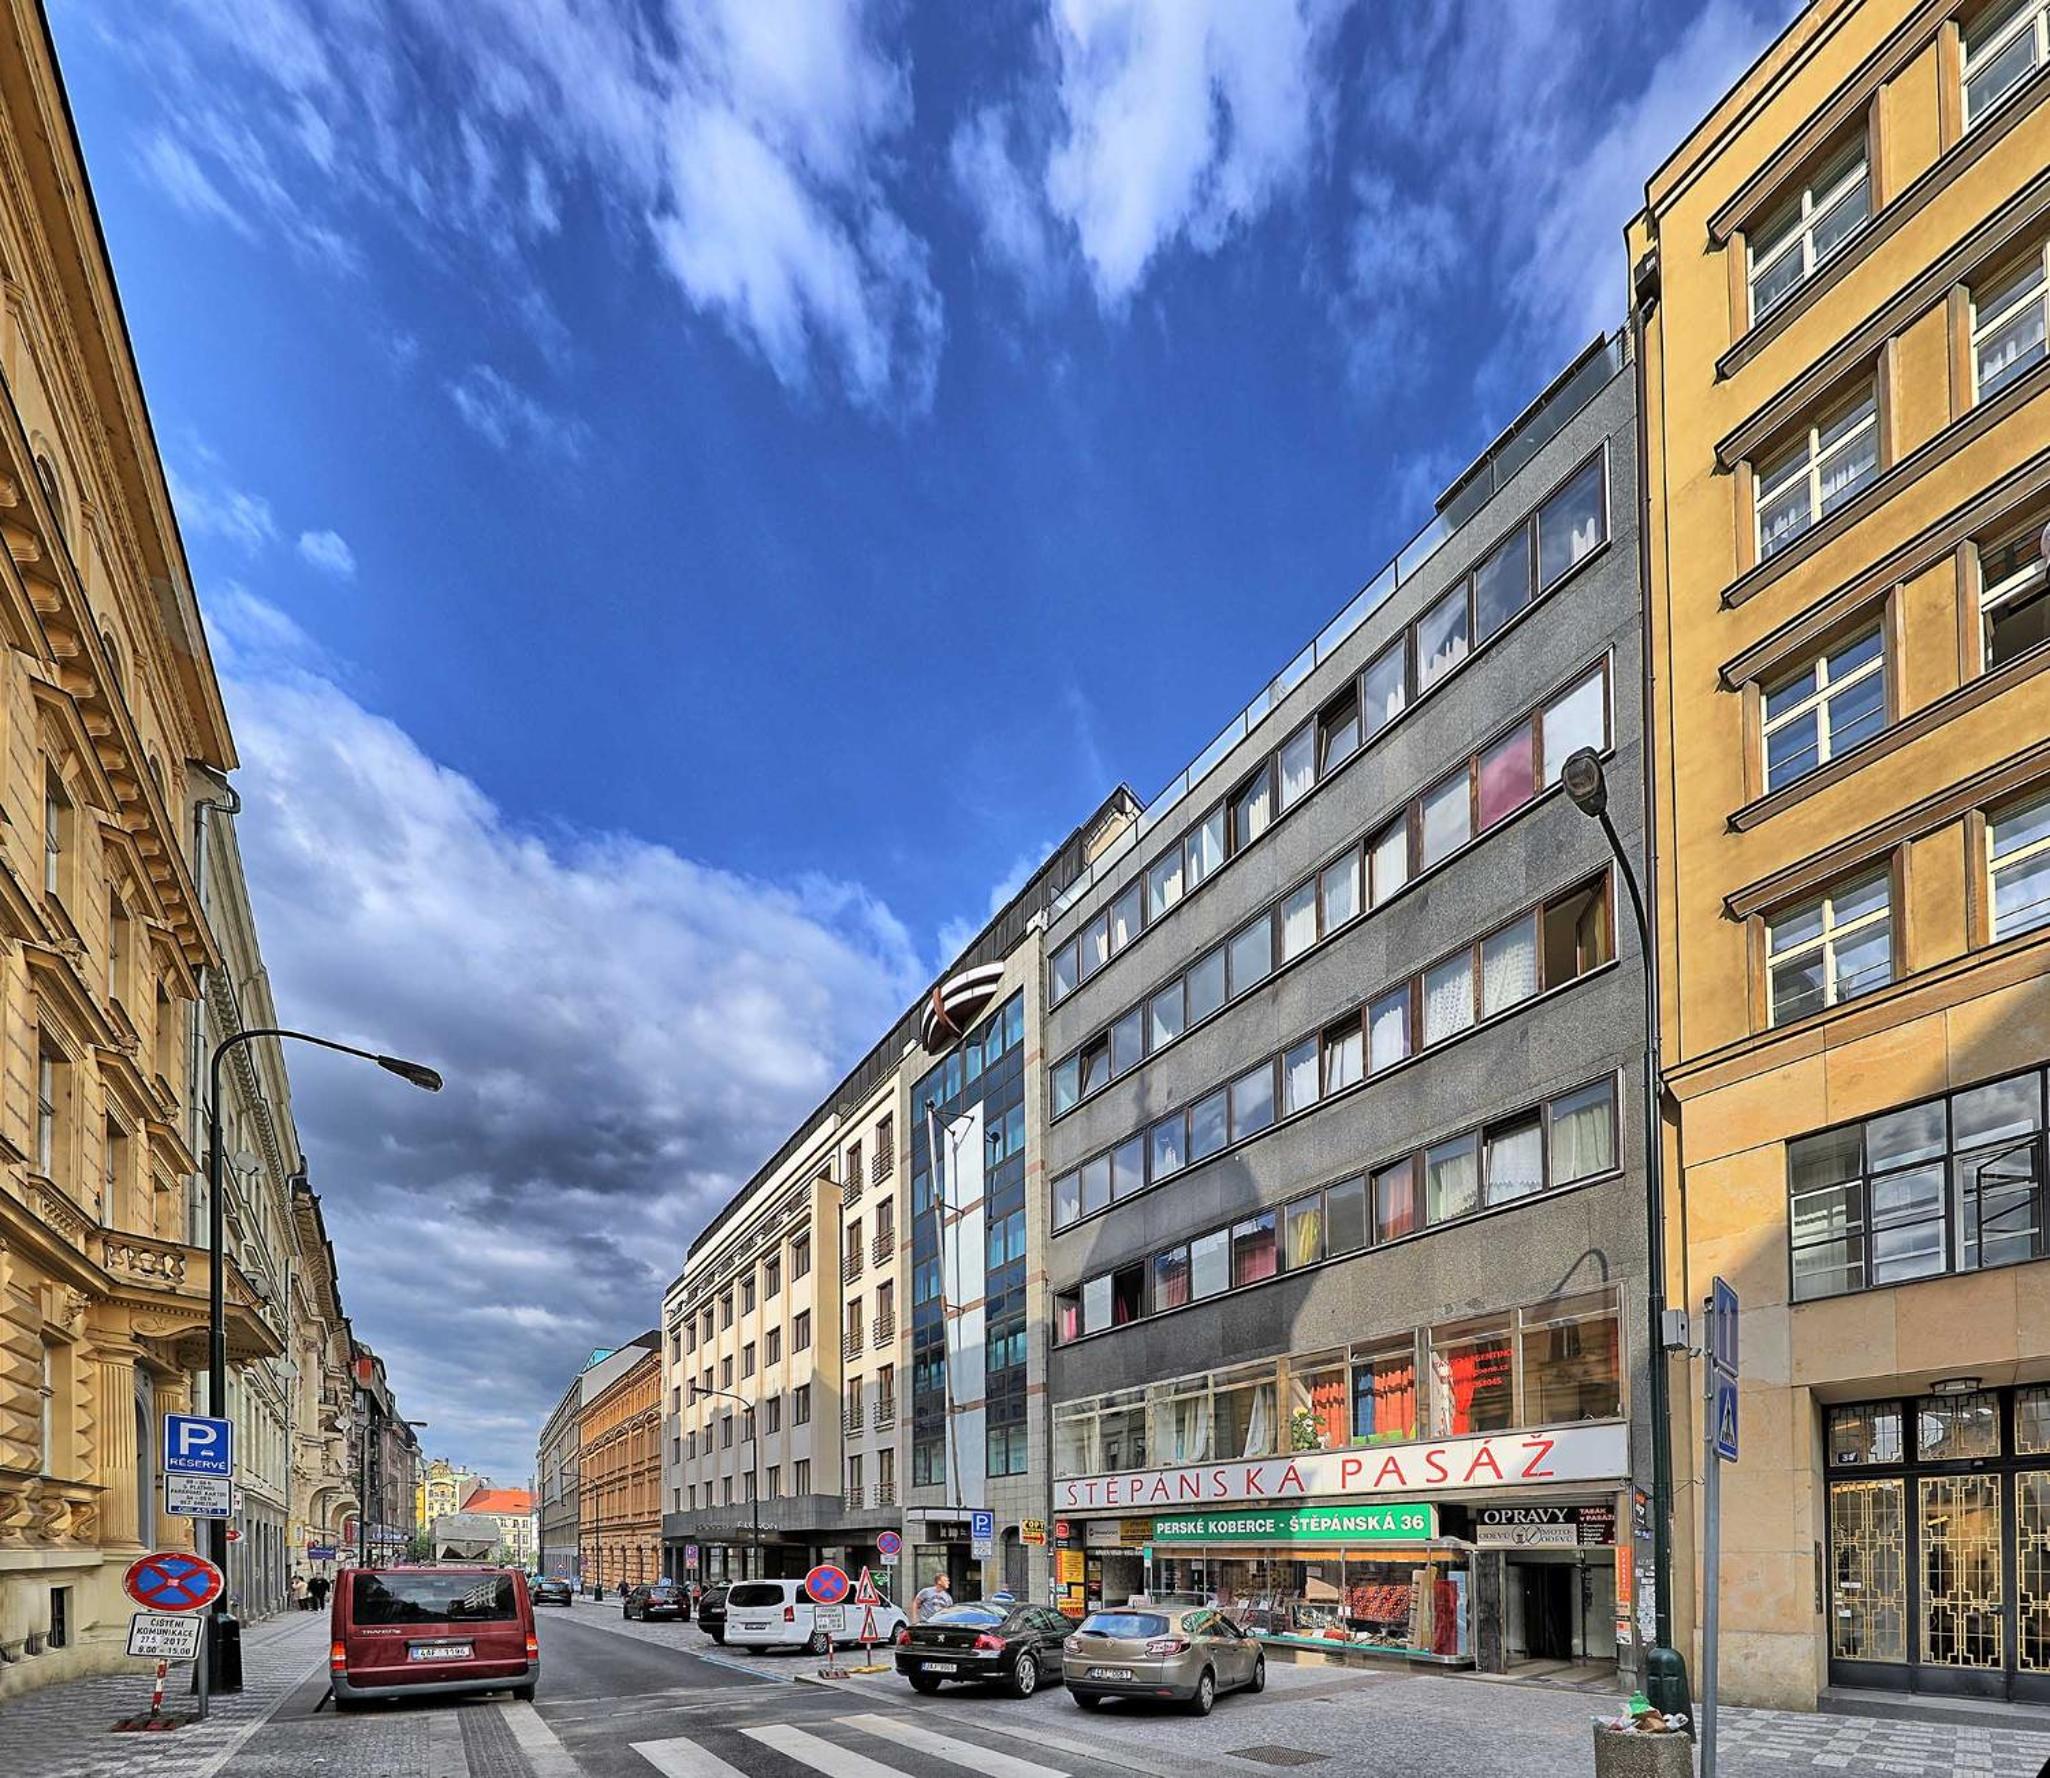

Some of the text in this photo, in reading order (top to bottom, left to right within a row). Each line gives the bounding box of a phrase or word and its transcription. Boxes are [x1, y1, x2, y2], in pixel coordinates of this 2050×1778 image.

[180, 1422, 217, 1455] P
[169, 1458, 226, 1470] RÉSERVÉ
[1067, 1434, 1554, 1506] ŠTĚPÁNSKÁ PASÁŽ
[976, 1515, 988, 1531] P
[1156, 1518, 1204, 1535] PERSKÉ
[1208, 1518, 1275, 1534] KOBERCE
[1289, 1511, 1396, 1532] ŠTĚPÁNSKÁ
[1401, 1514, 1425, 1530] 36
[1483, 1507, 1568, 1524] OPRAVY
[151, 1617, 185, 1628] ČIŠTĚNÍ
[136, 1626, 194, 1638] KOMUNIKACE
[163, 1637, 188, 1646] 2017
